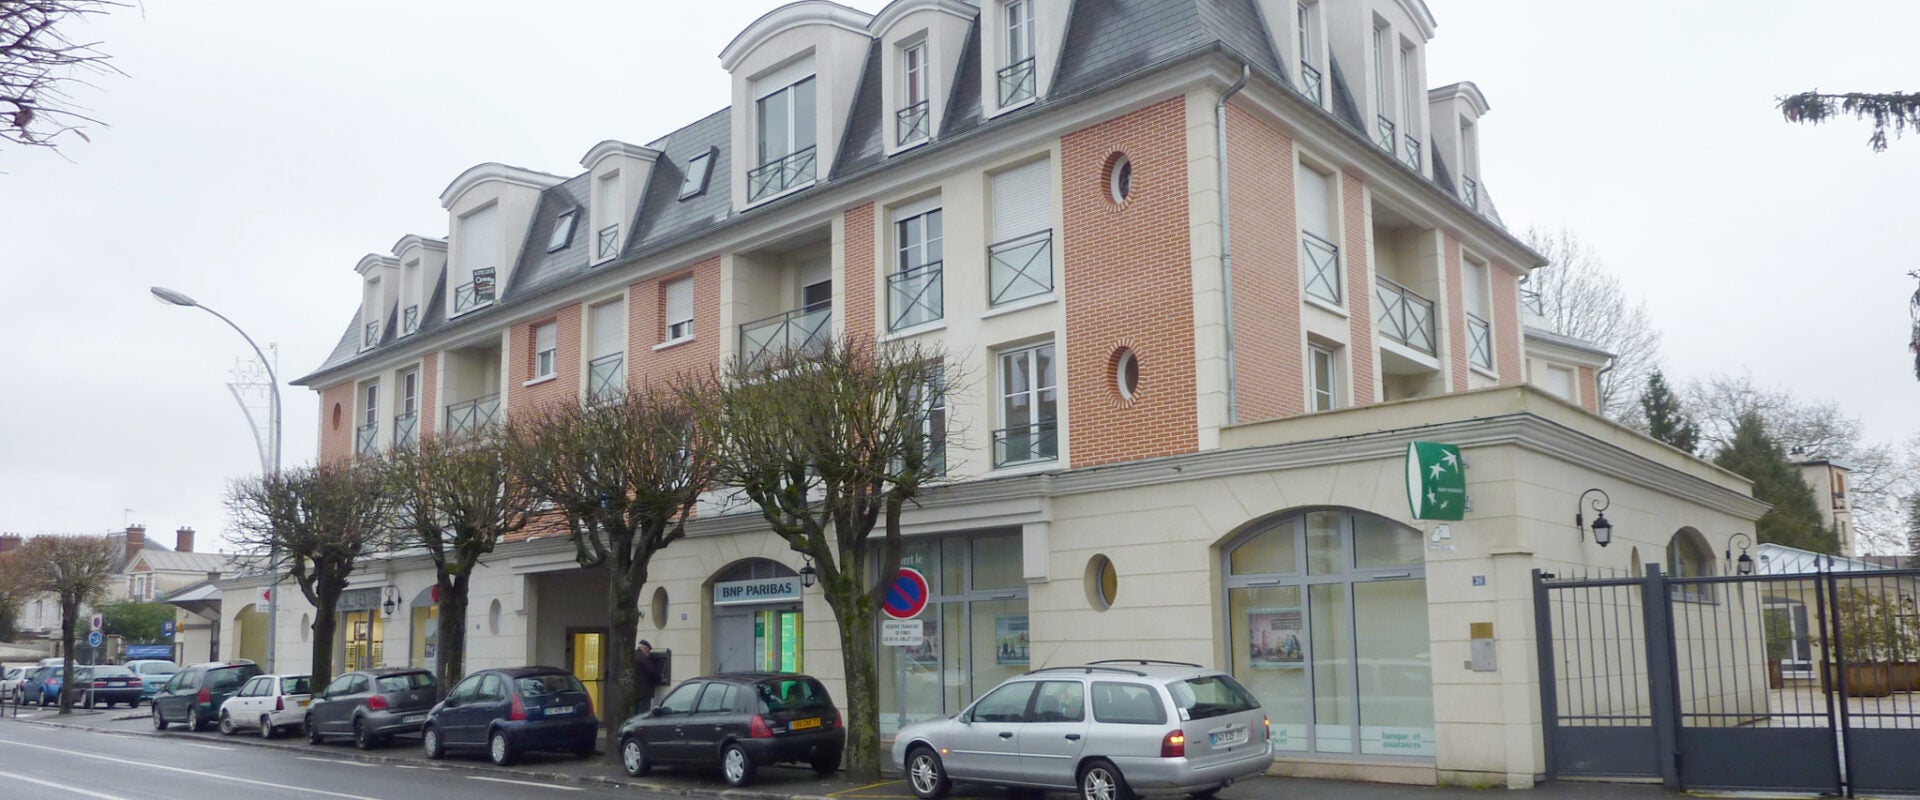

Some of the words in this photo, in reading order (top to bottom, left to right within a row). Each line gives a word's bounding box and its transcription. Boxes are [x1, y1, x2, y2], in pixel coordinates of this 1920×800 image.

[722, 585, 743, 598] BNP
[746, 582, 792, 596] PARIBAS
[1382, 731, 1409, 741] banque
[1413, 732, 1421, 741] et
